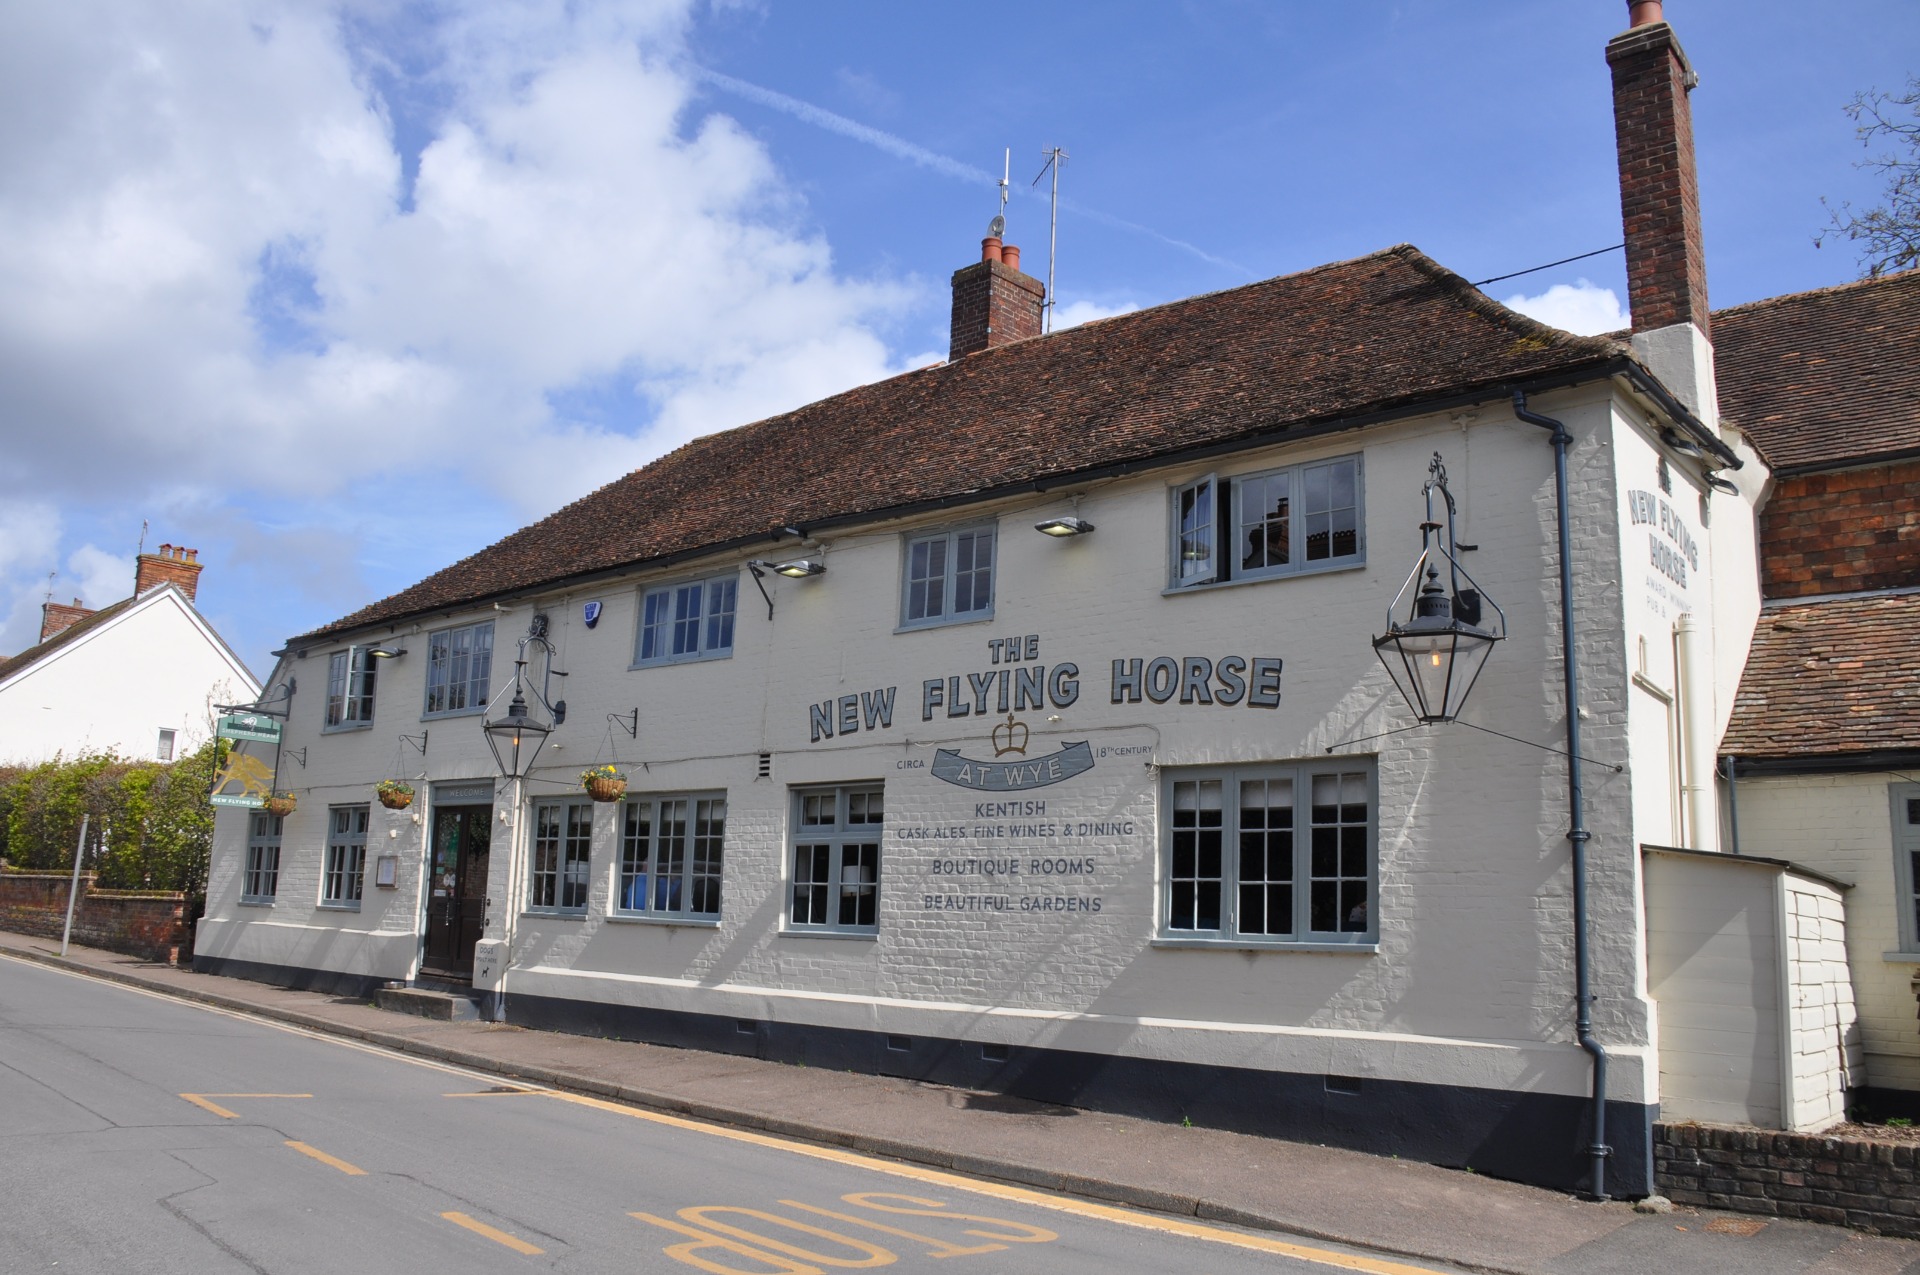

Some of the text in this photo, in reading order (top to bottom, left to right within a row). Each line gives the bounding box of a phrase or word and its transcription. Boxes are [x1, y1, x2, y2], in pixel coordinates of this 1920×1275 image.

[1627, 489, 1698, 572] NEW FLYING
[1649, 533, 1687, 589] HORSE
[1646, 595, 1659, 613] PUB
[988, 634, 1040, 665] THE
[809, 655, 1283, 743] NEW FLYING HORSE
[1115, 745, 1153, 756] CENTURY
[897, 760, 925, 770] CIRCA
[956, 757, 1063, 787] AT WYE
[228, 798, 251, 806] FLYING
[449, 788, 485, 798] WELCOME
[975, 800, 1046, 818] KENTISH
[897, 827, 929, 839] CASK
[974, 825, 1004, 838] FINE
[1009, 824, 1055, 837] WINES
[1063, 824, 1073, 836] &
[1078, 821, 1134, 837] DINING
[932, 858, 1095, 876] BOUTIQUE ROOMS
[924, 895, 1102, 912] BEAUTIFUL GARDENS
[479, 946, 494, 955] DOGS
[625, 1192, 1059, 1275] STOP
